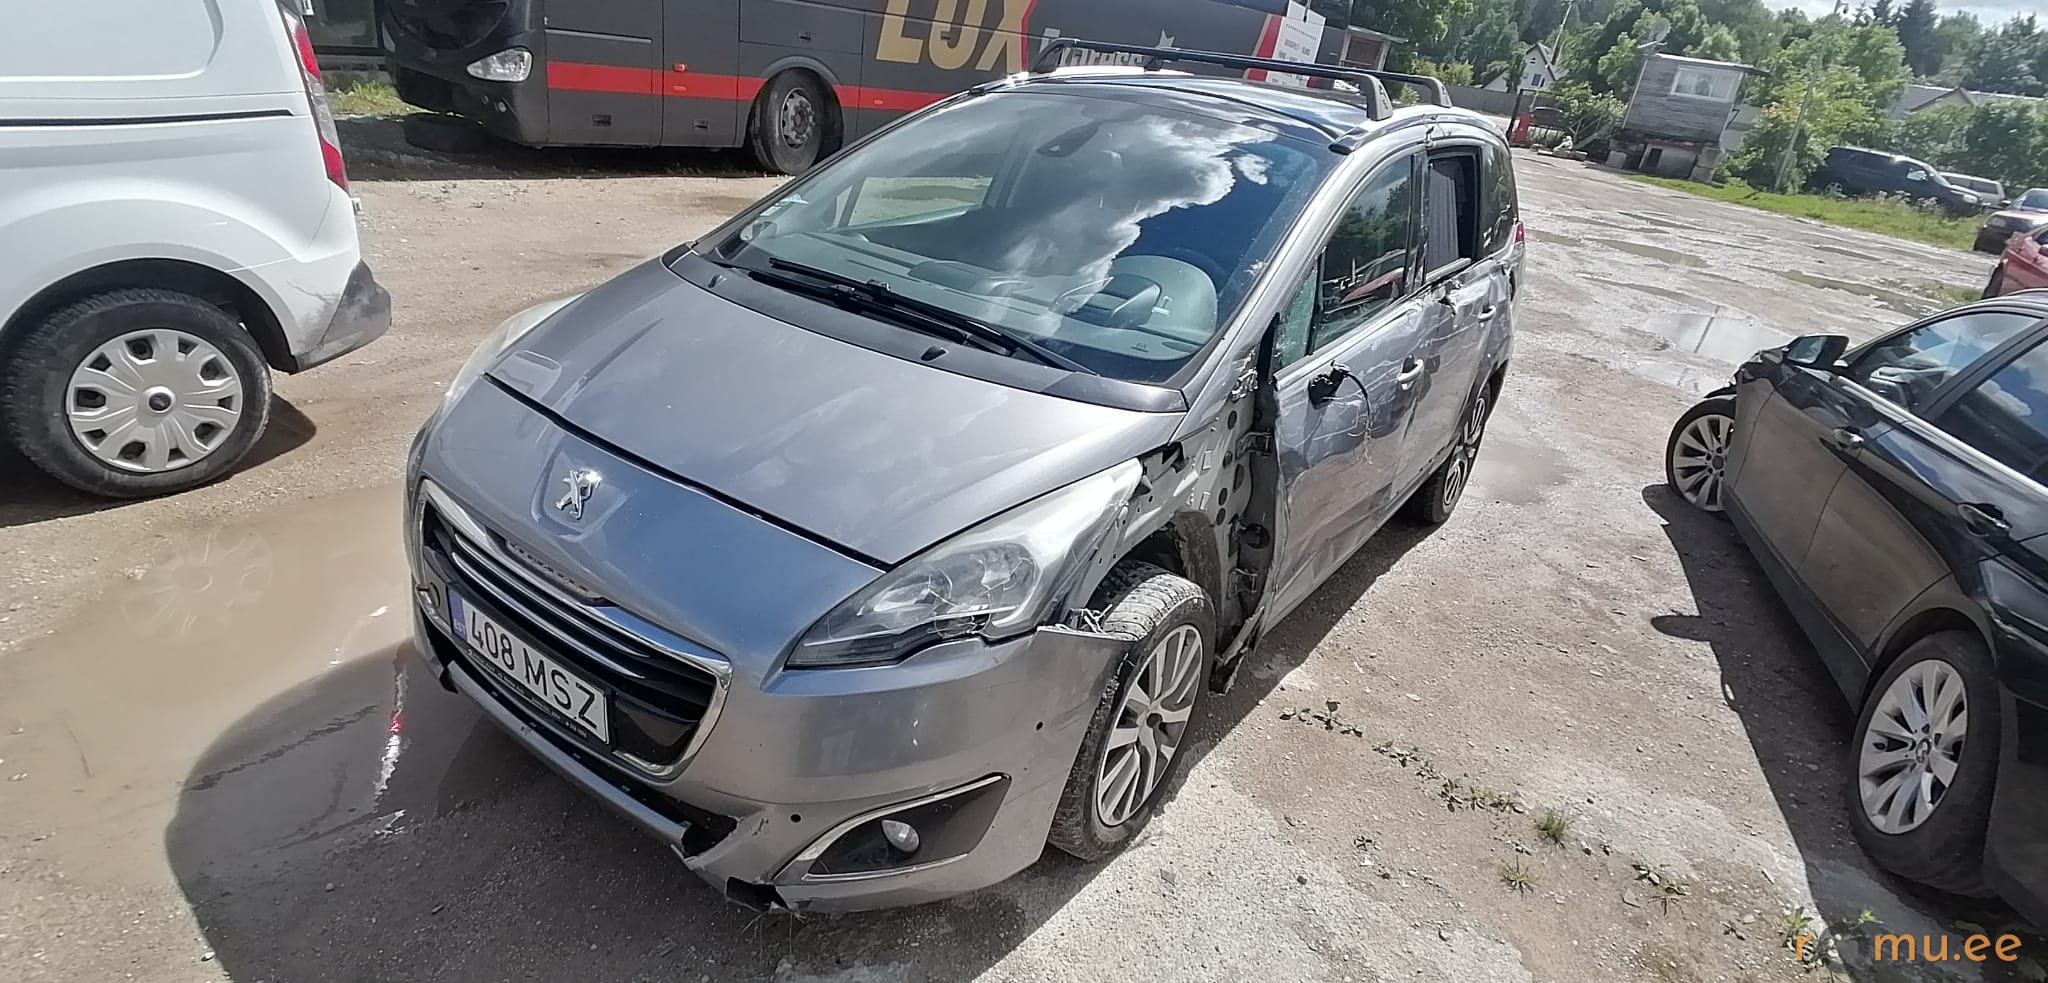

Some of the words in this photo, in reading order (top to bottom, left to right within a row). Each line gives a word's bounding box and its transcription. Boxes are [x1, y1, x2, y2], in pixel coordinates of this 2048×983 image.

[876, 0, 1030, 74] LUX
[472, 611, 515, 670] 408
[523, 648, 598, 729] MSZ
